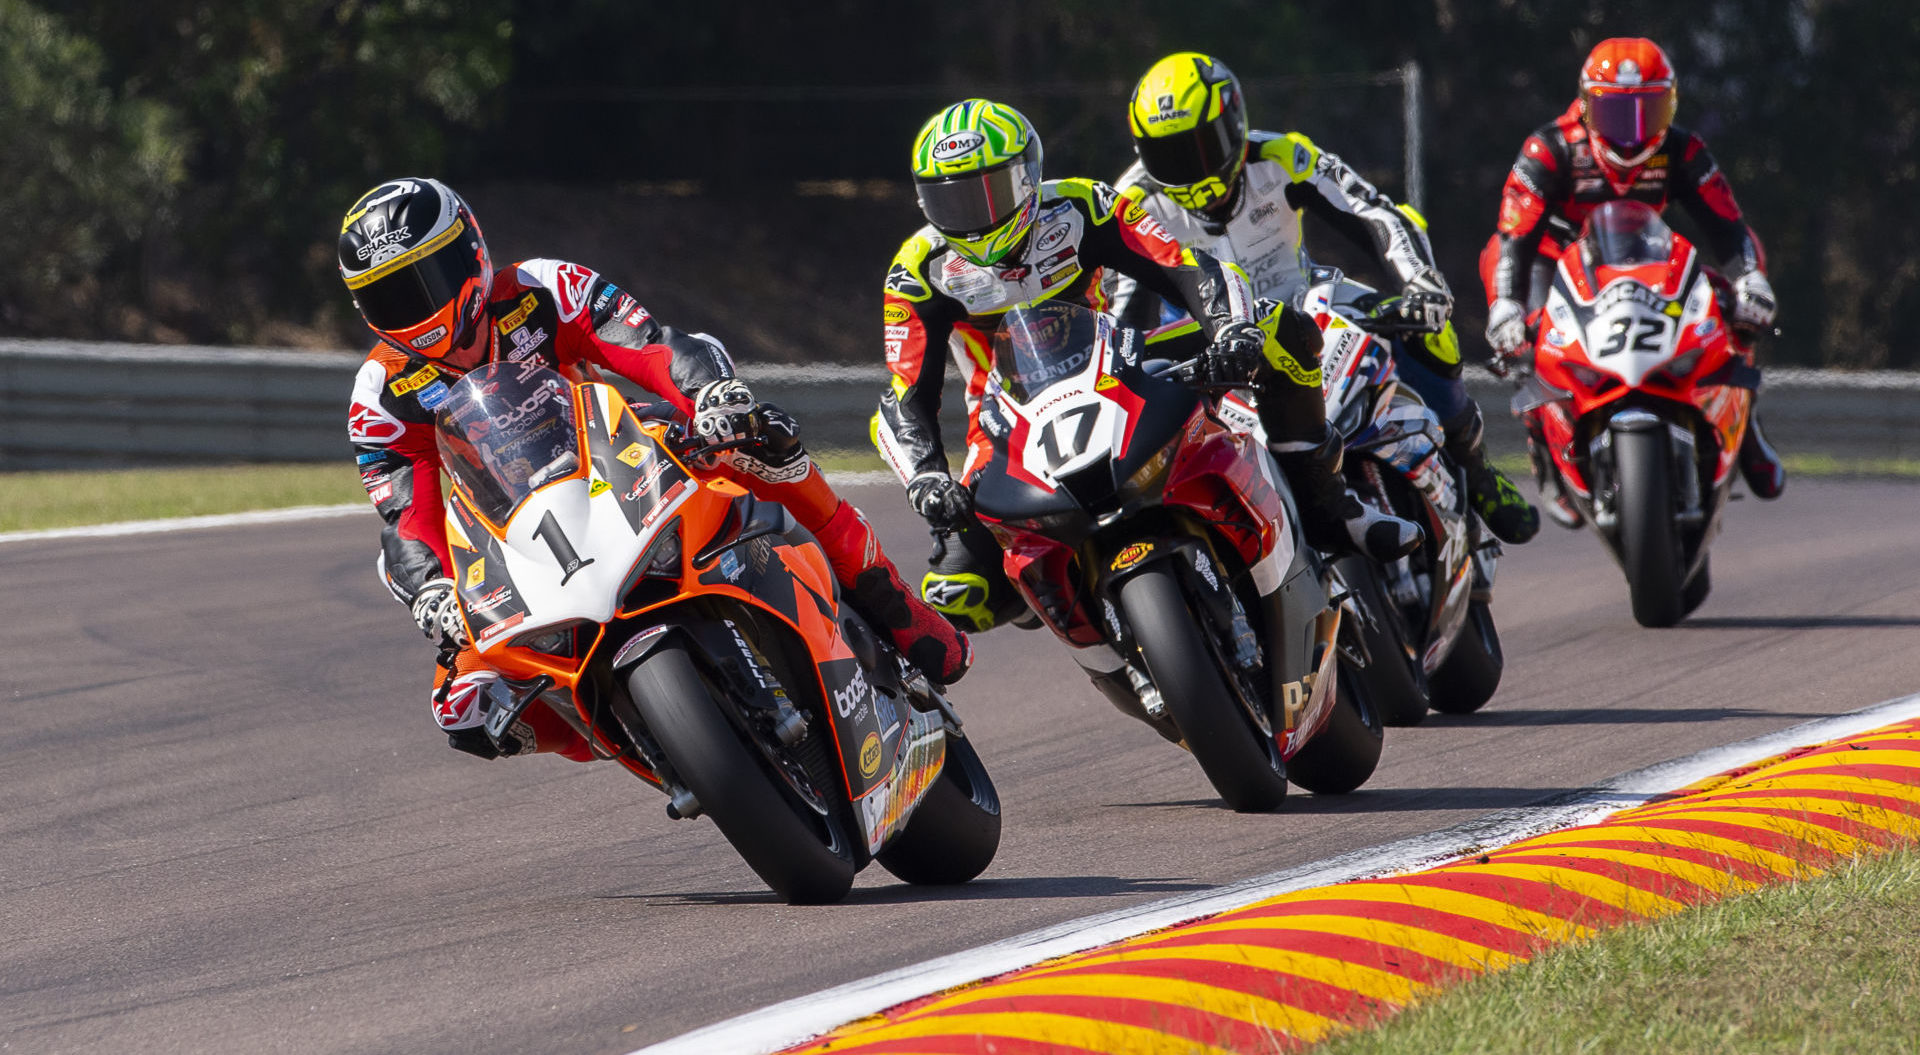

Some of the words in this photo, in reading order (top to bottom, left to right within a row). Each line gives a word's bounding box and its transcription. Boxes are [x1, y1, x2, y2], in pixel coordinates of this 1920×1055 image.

[934, 136, 982, 155] SUOMY
[358, 226, 411, 260] SHARK
[508, 327, 548, 362] SHARK
[1599, 317, 1665, 358] 32
[395, 367, 435, 393] PIRELLI
[1035, 388, 1083, 417] HONDA
[500, 407, 547, 438] mobile
[1036, 402, 1101, 479] 17
[532, 509, 595, 587] 1
[723, 619, 767, 689] PIRELLI
[834, 662, 869, 718] boost
